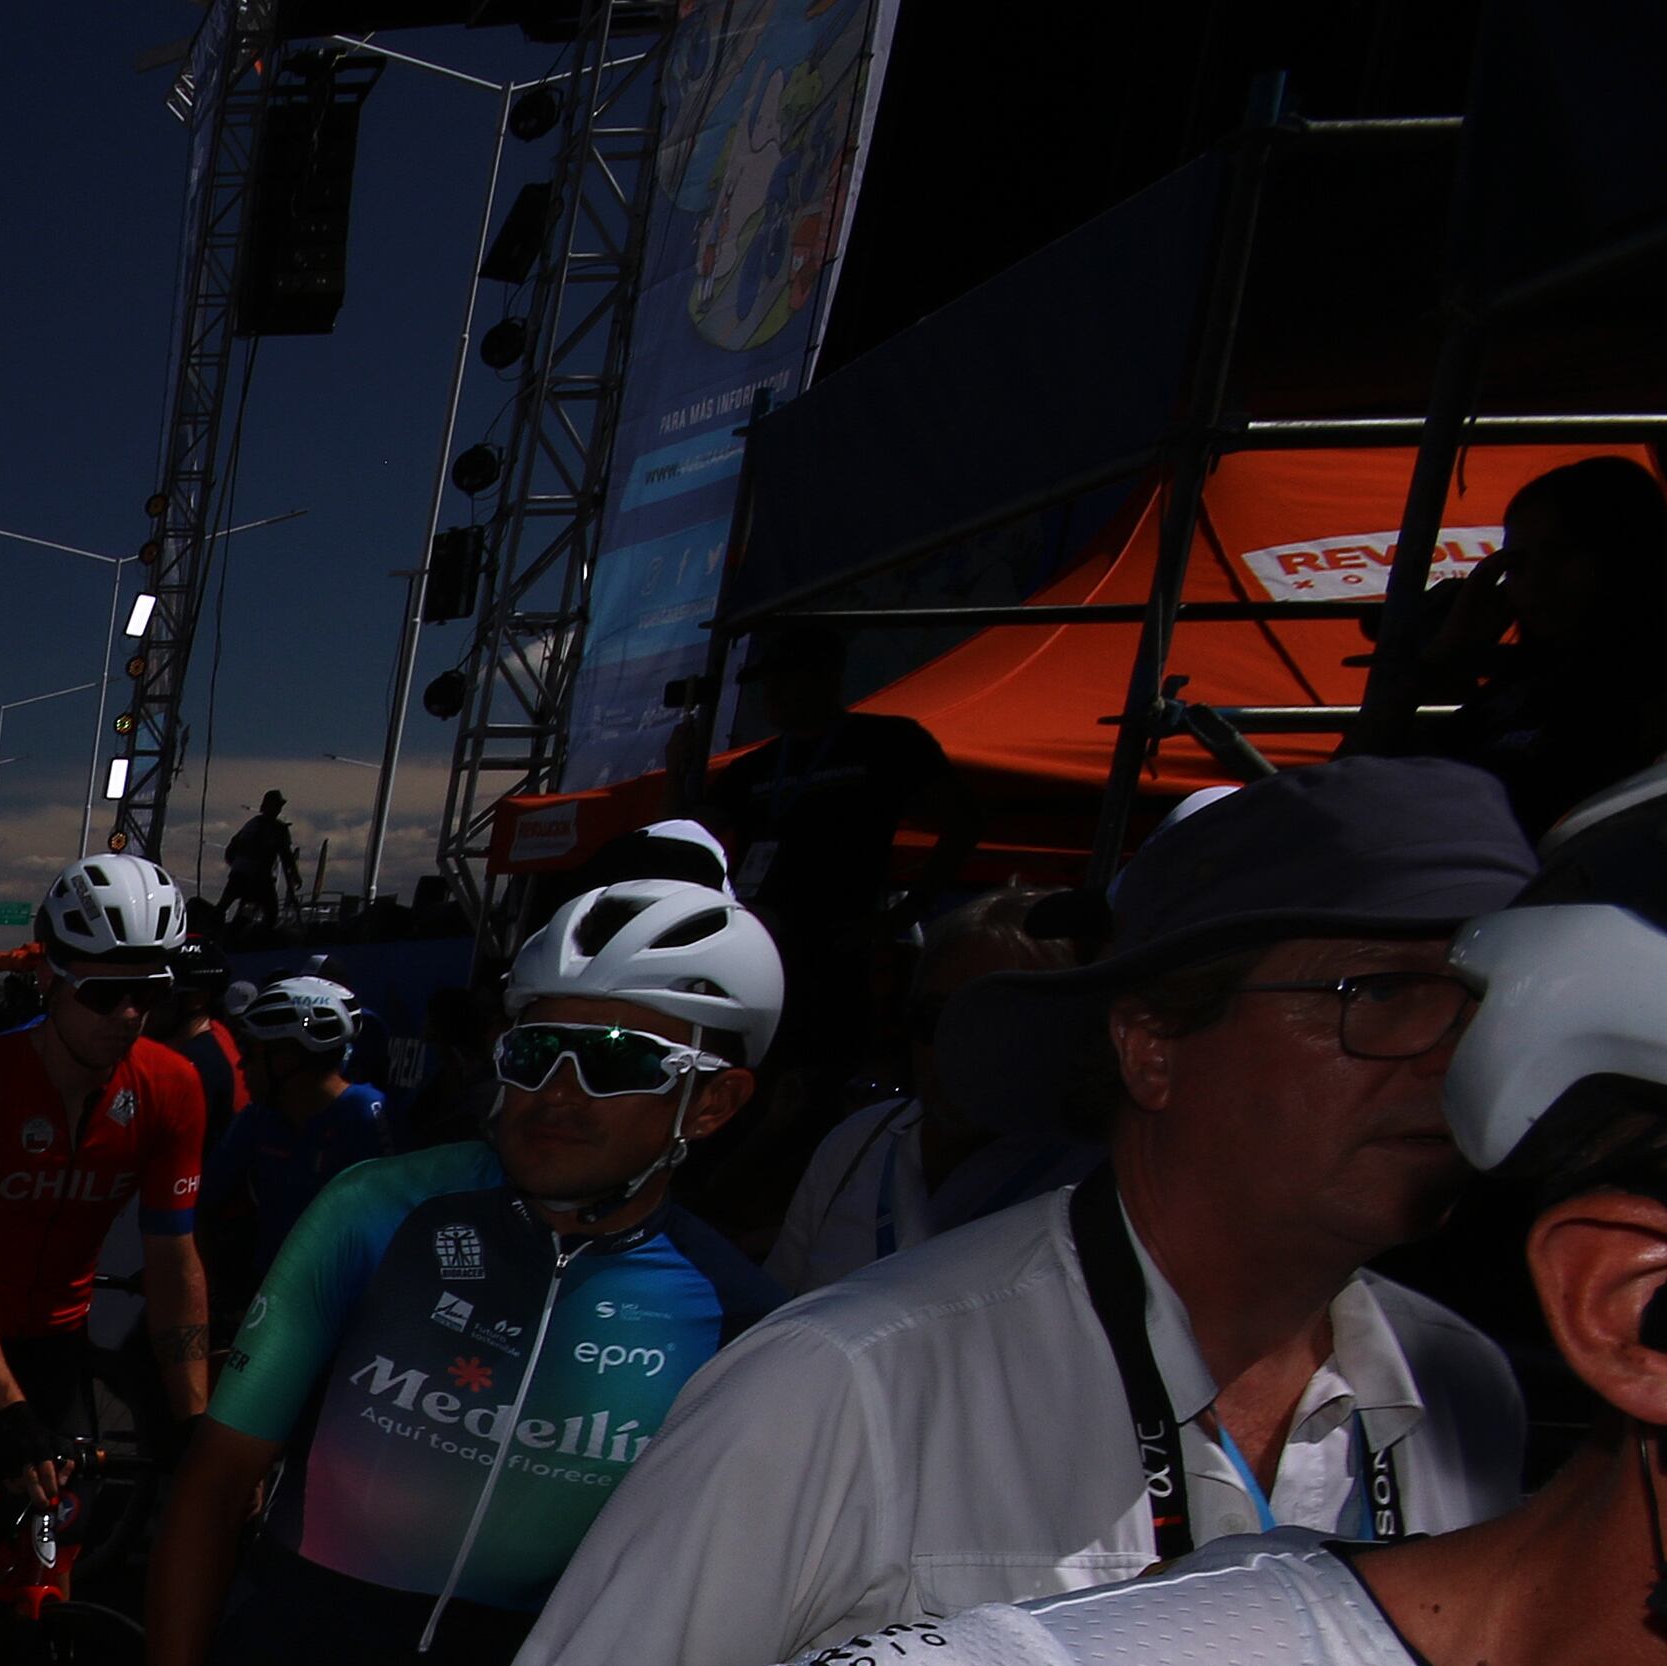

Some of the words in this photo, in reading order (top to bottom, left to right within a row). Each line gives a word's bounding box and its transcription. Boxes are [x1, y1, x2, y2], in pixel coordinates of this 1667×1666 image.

[359, 1405, 426, 1441] Aquí
[429, 1432, 495, 1467] todo
[506, 1454, 613, 1488] florece
[1370, 1448, 1397, 1536] SON
